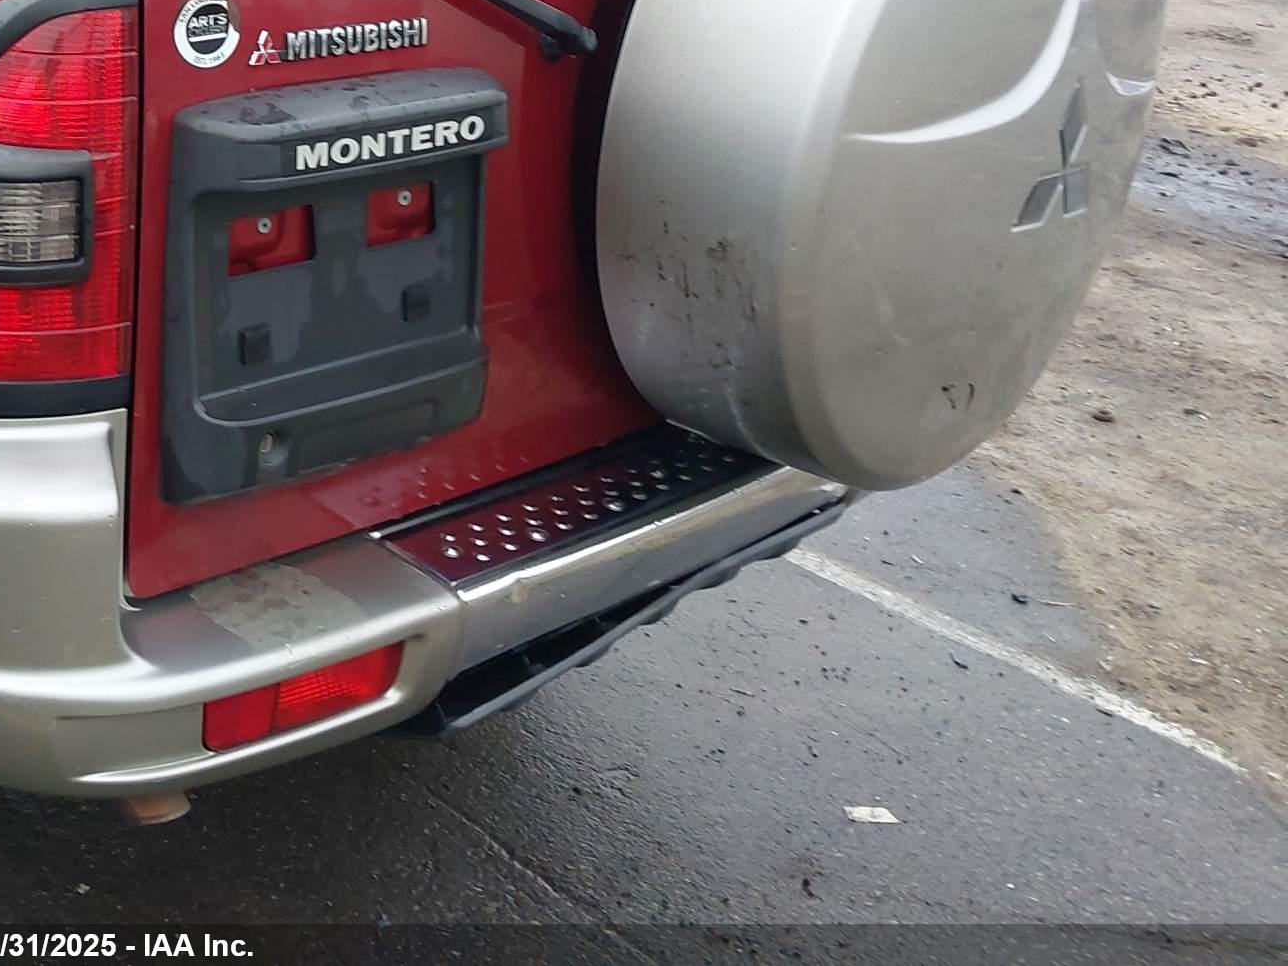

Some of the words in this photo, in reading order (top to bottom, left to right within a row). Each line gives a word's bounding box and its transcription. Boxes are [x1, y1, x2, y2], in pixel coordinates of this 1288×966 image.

[187, 12, 228, 29] ARTS
[286, 18, 428, 61] MITSUBISHI
[295, 115, 486, 171] MONTERO
